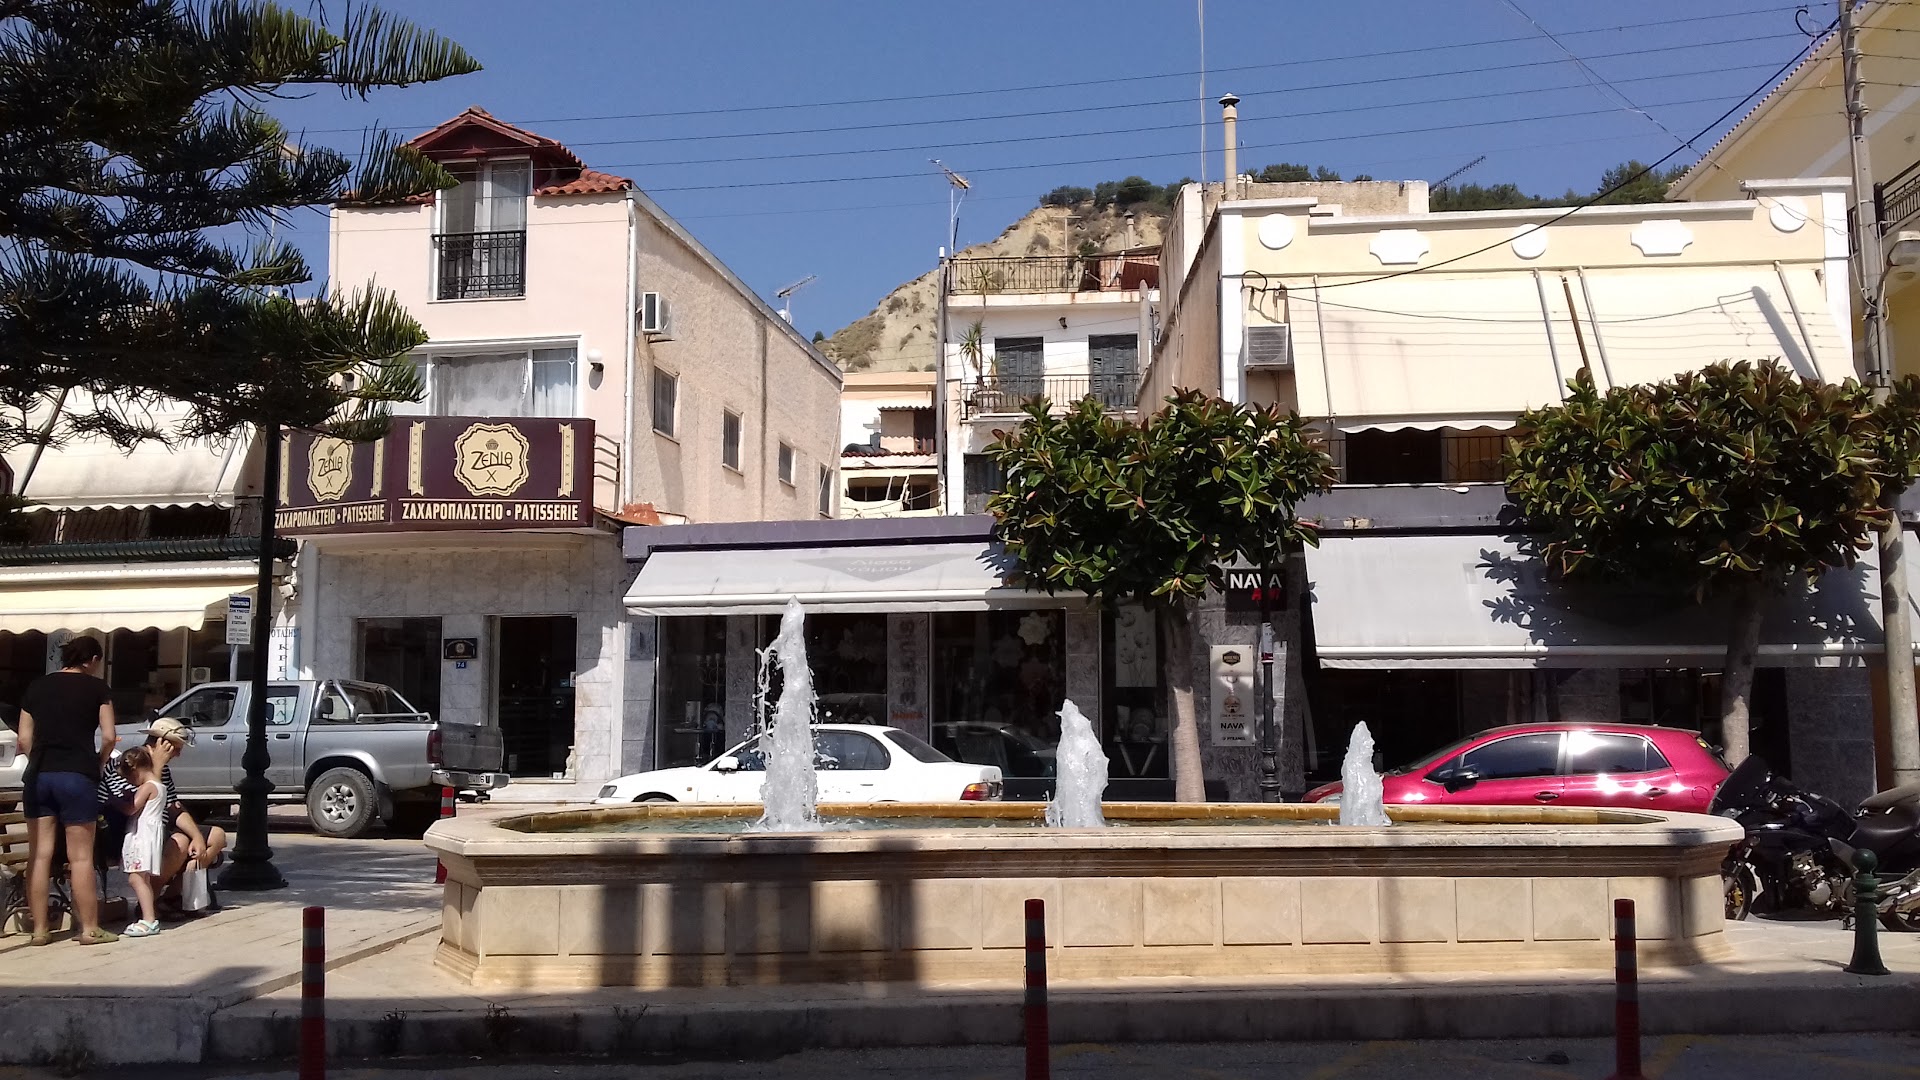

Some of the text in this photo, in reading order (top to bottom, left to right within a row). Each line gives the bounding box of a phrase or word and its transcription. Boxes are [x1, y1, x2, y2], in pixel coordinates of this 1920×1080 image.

[274, 503, 385, 529] ΖΑΧΑΡΟΠΛΑΣΤΕΙΟ PATISSERIE
[402, 502, 579, 521] ΖΑΧΑΡΟΠΛΑΣΤΕΙΟ PATISSERIE
[1220, 722, 1245, 730] NAVA
